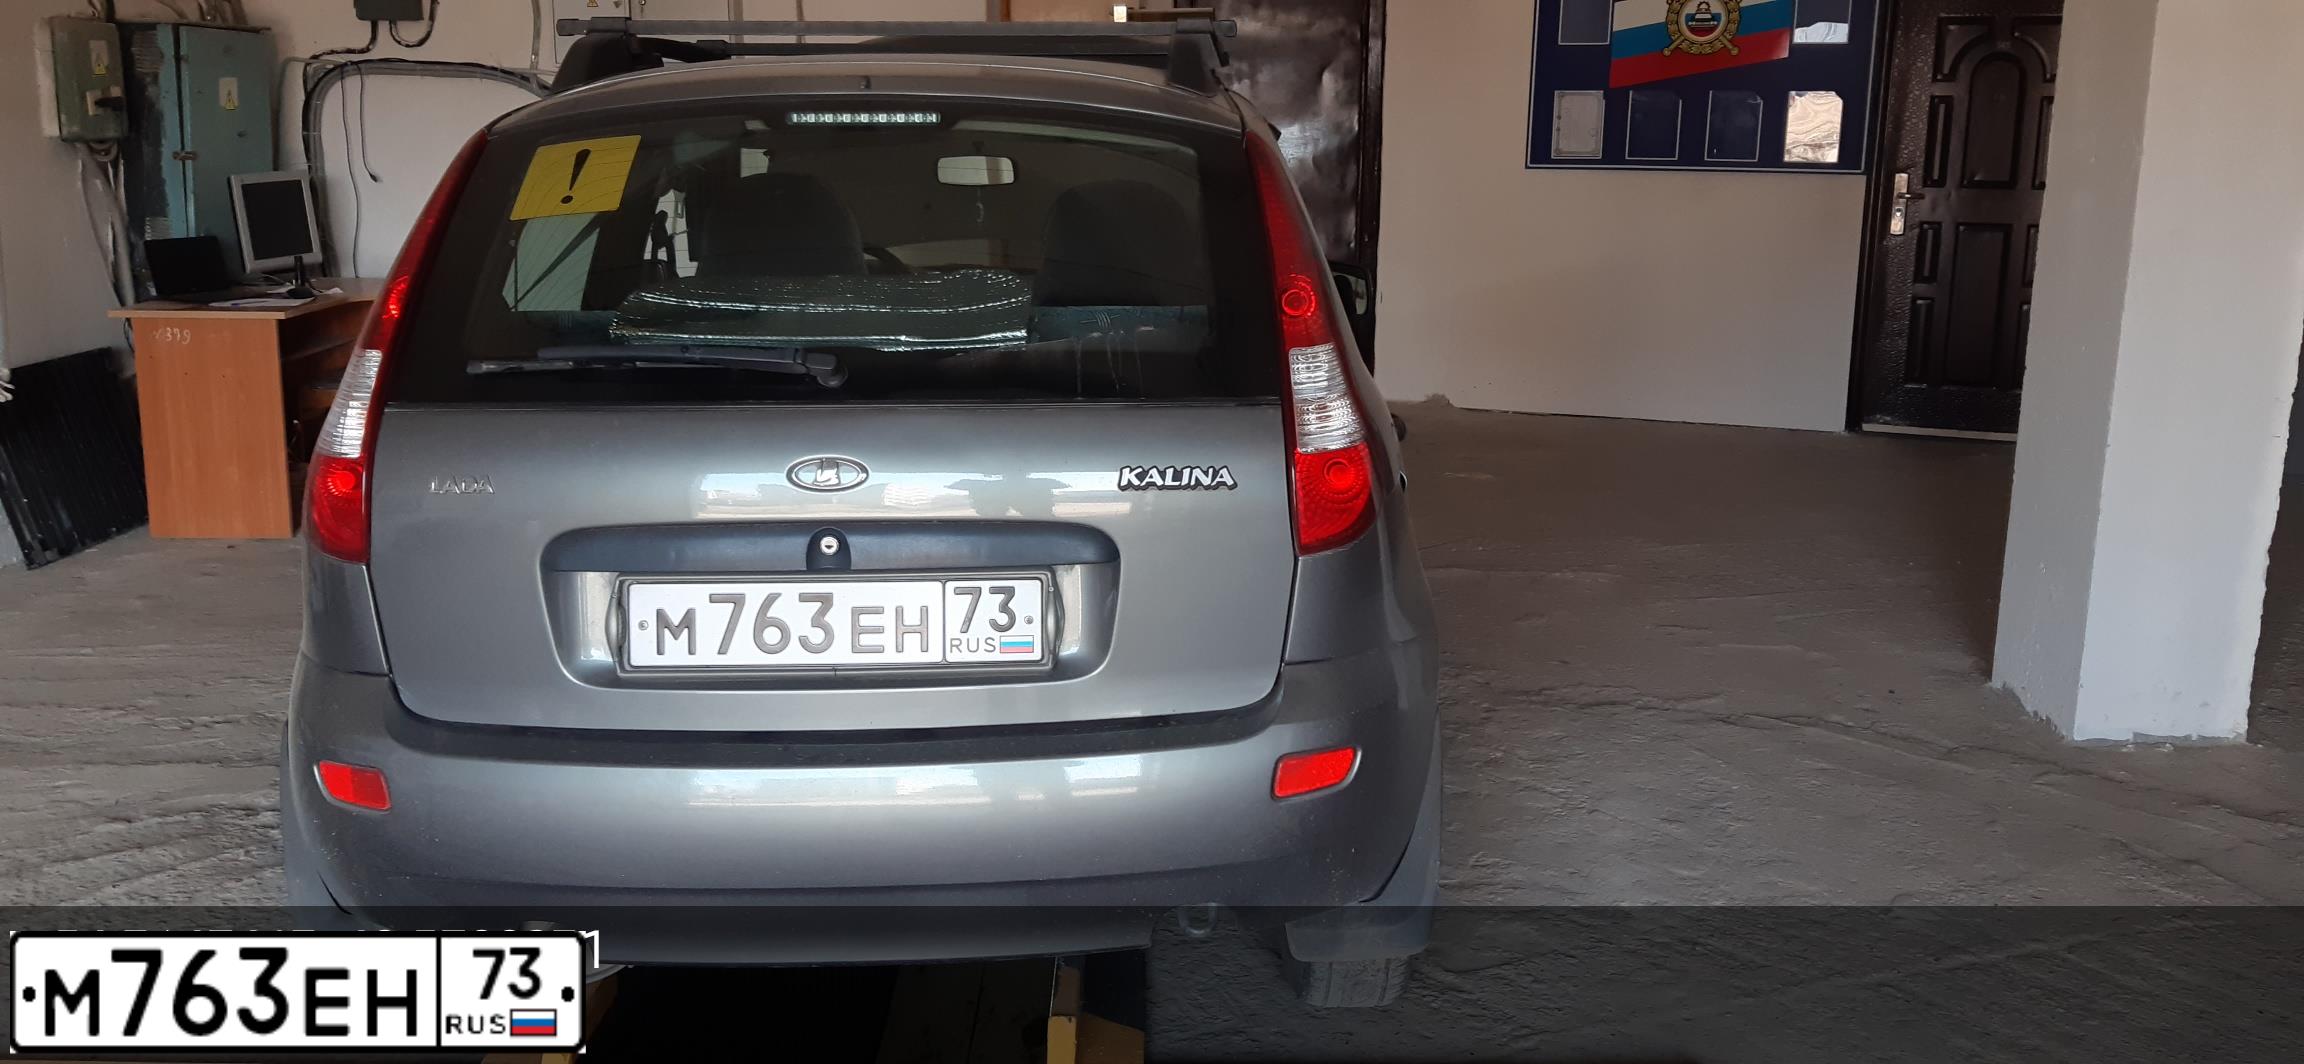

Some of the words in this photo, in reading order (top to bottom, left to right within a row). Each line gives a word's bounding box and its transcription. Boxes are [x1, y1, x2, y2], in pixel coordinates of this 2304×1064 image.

[429, 475, 495, 495] LADA
[1118, 465, 1238, 491] KALINA
[953, 586, 1017, 634] 73
[949, 637, 997, 654] RUS
